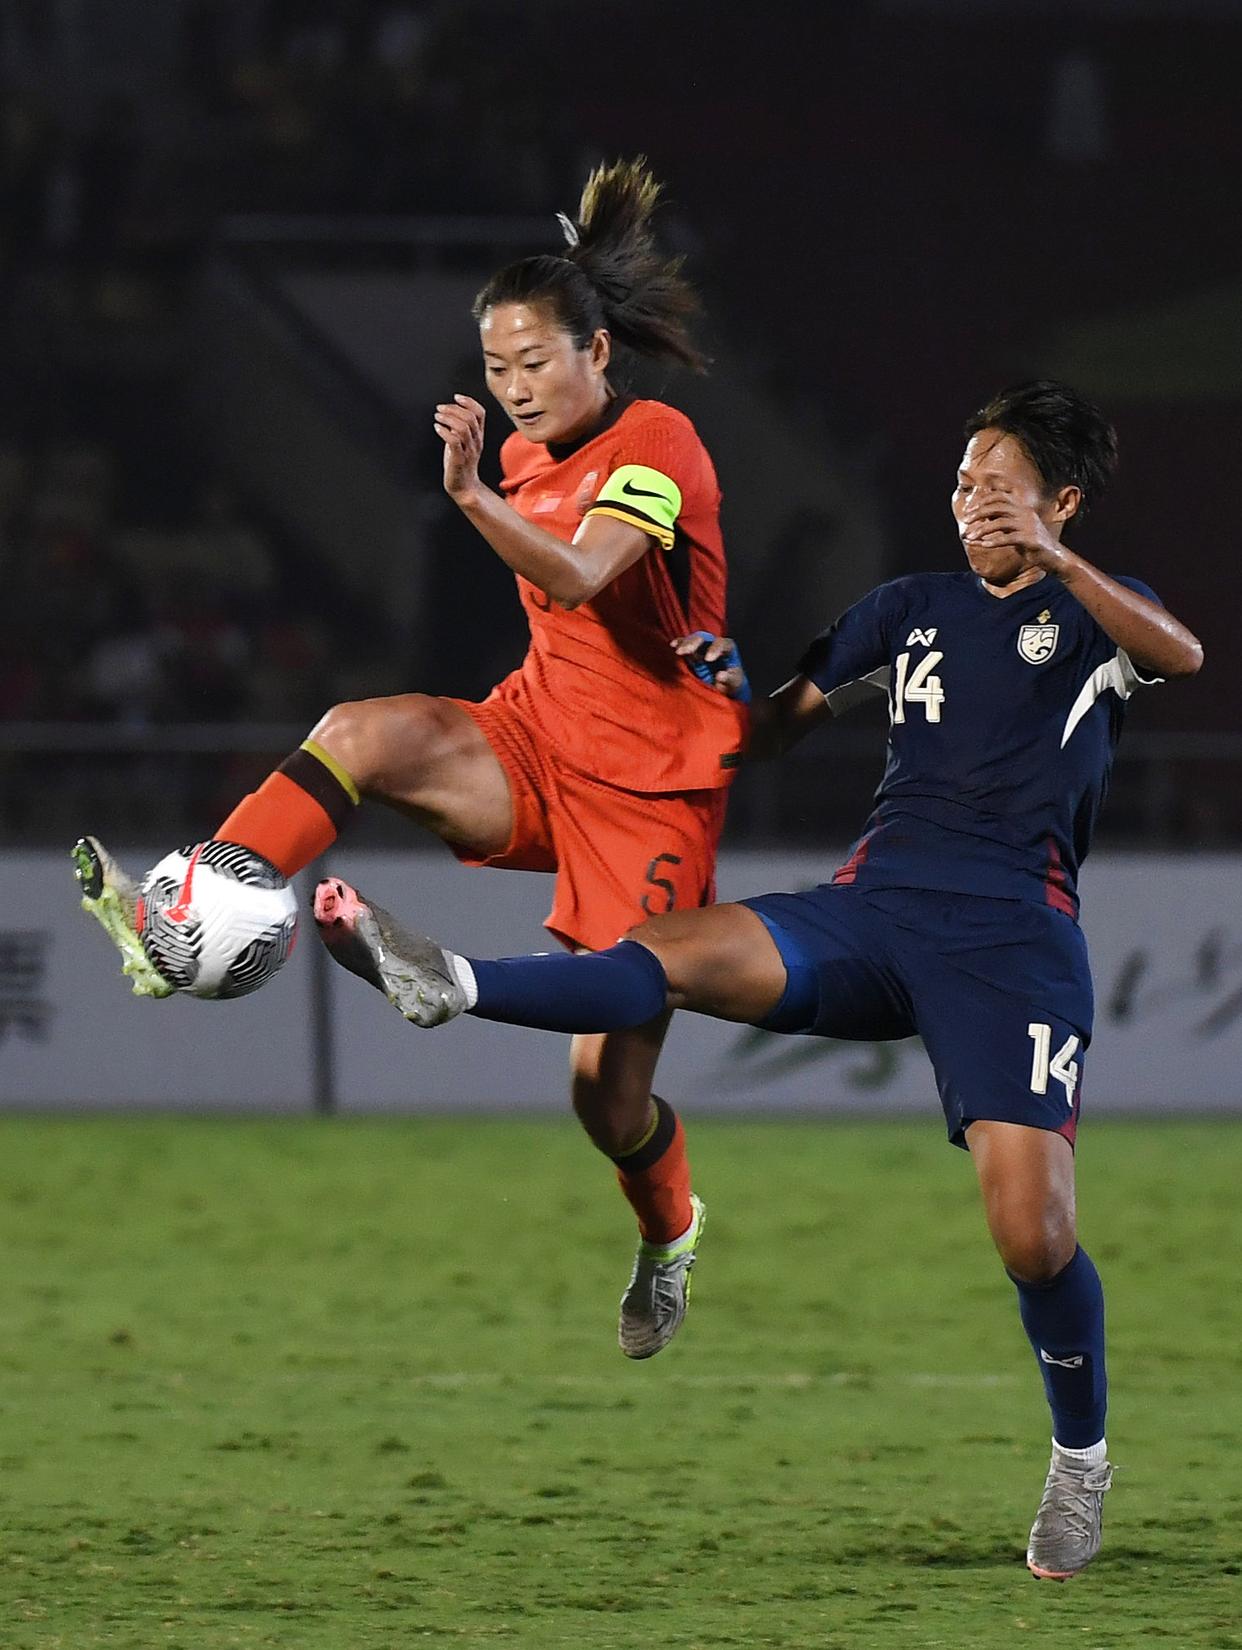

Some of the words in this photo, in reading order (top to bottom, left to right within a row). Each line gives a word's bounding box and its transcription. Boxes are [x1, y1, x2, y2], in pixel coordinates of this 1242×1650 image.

[894, 651, 945, 724] 14
[640, 853, 682, 916] 5
[1028, 1023, 1079, 1108] 14
